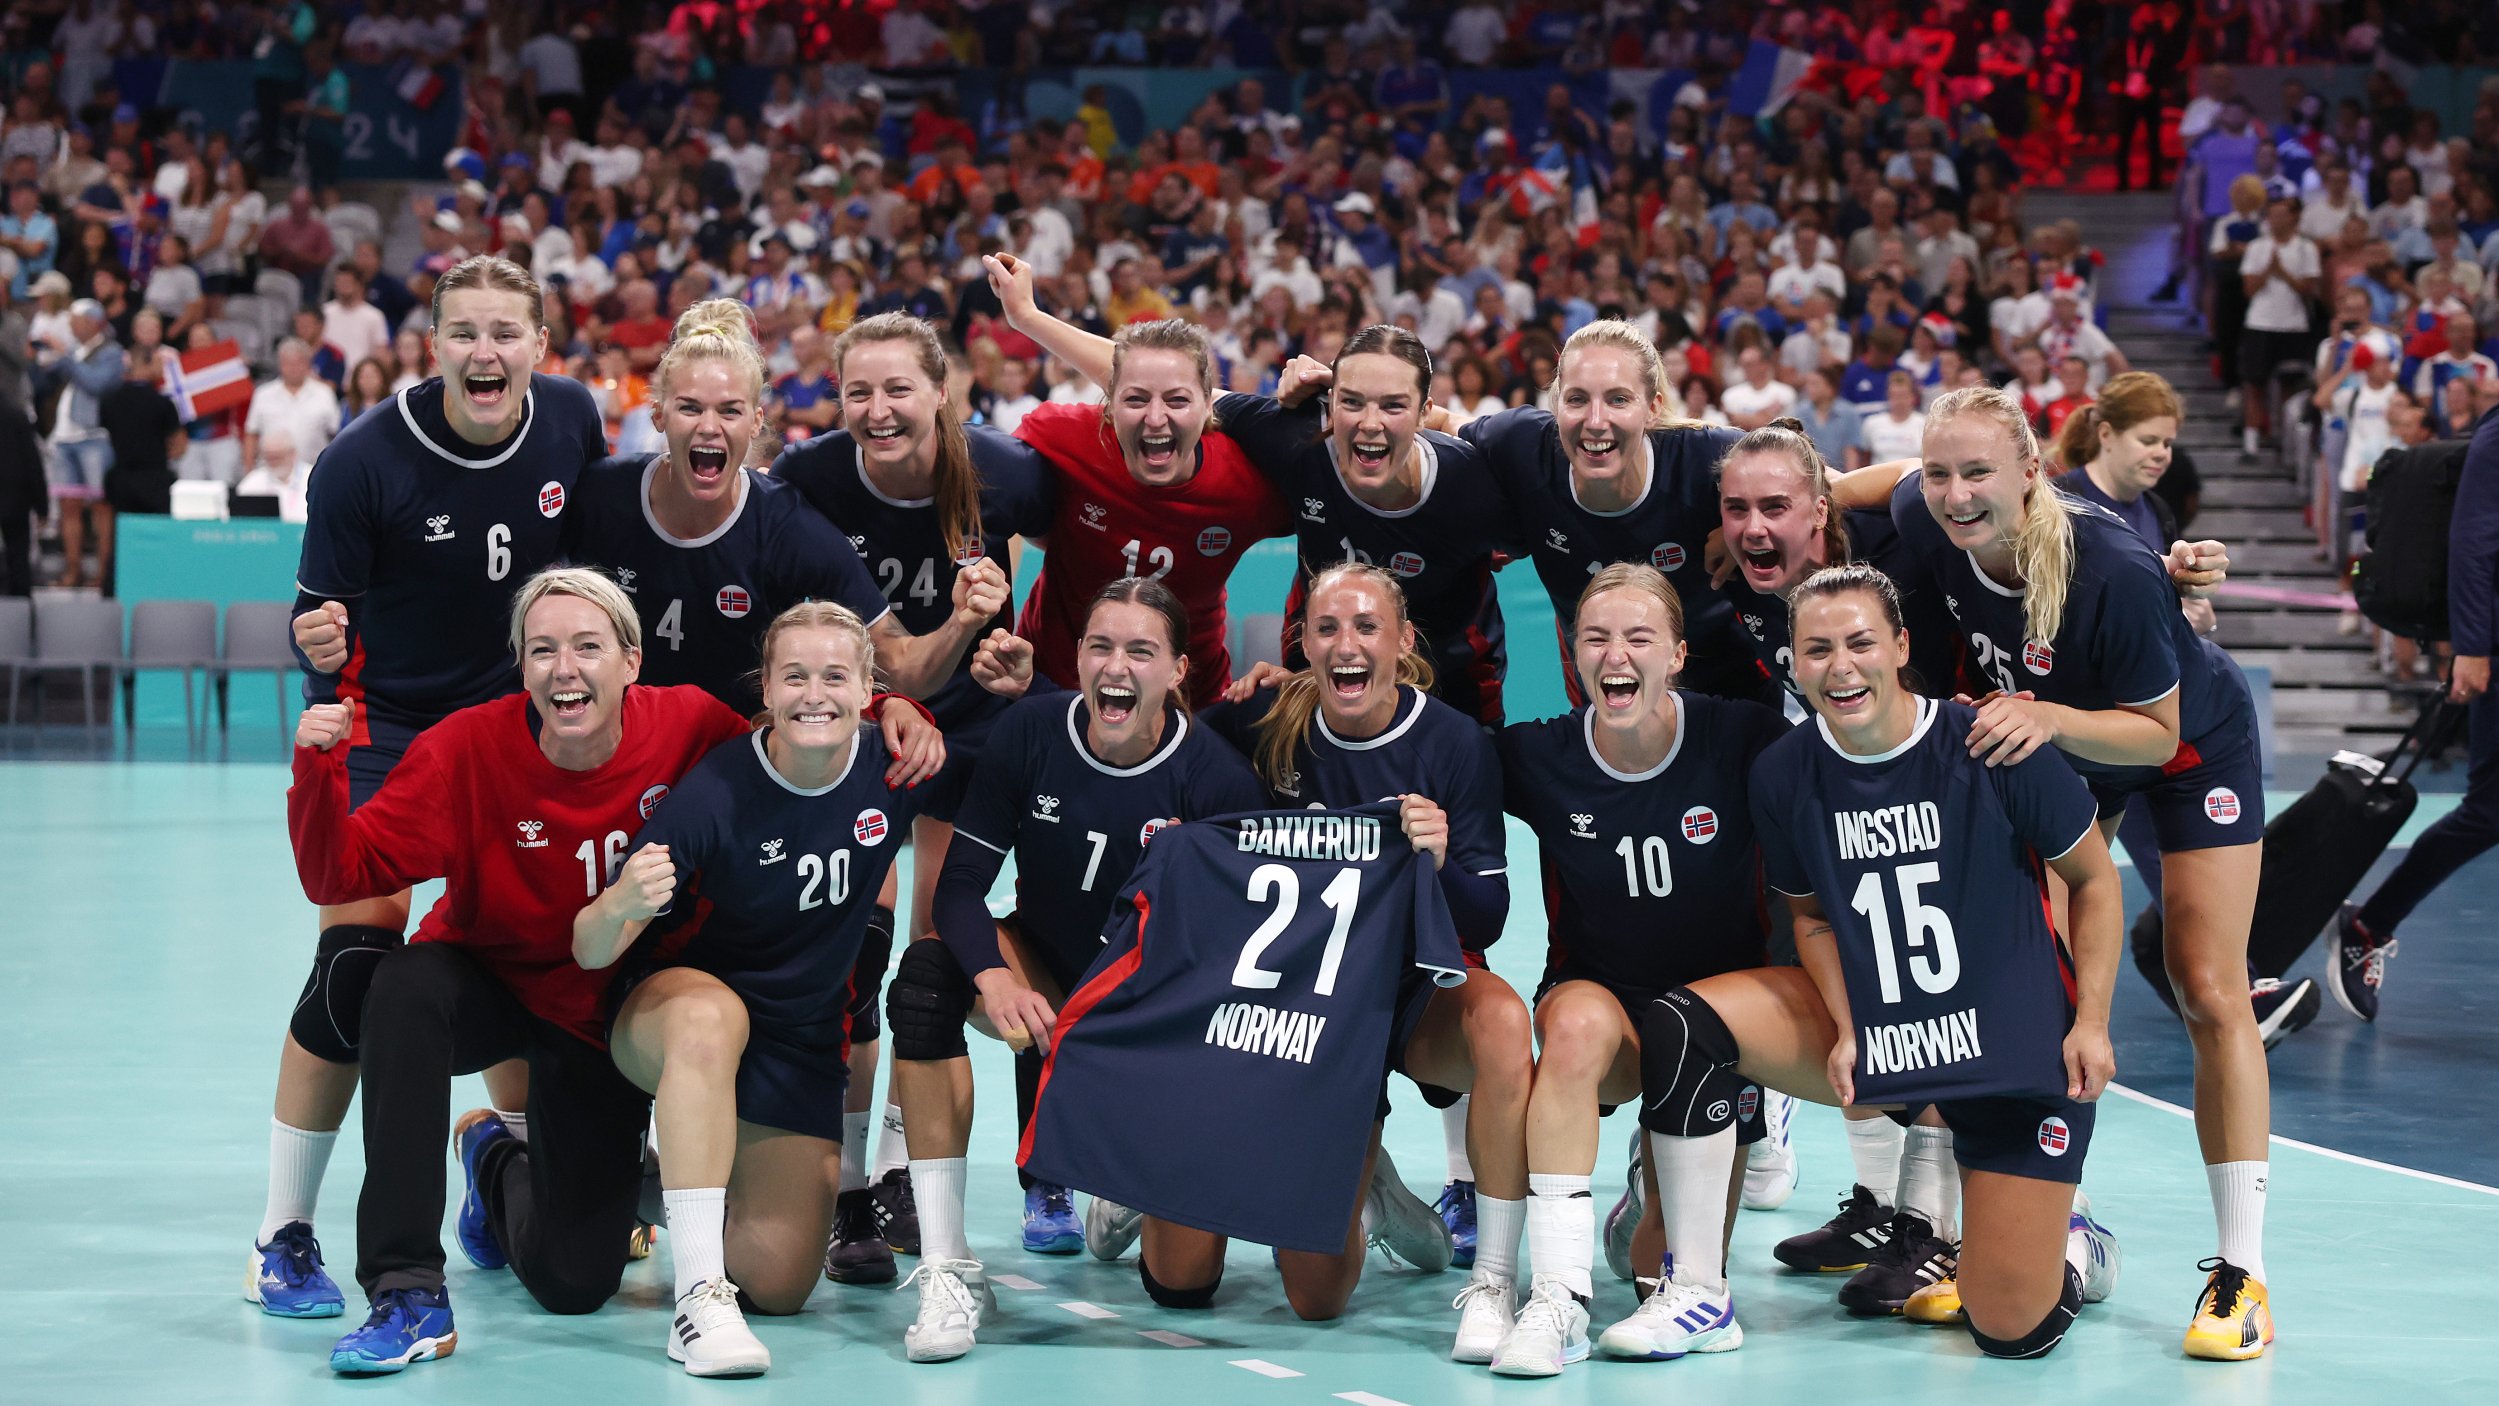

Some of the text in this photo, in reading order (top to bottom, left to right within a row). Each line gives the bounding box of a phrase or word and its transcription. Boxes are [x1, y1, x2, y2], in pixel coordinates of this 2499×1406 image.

[425, 530, 455, 542] hummel
[1079, 514, 1107, 532] hummel
[487, 523, 512, 581] 6
[1120, 539, 1174, 582] 12
[878, 557, 937, 611] 24
[656, 598, 685, 651] 4
[517, 837, 549, 848] hummel
[1031, 809, 1060, 823] hummel
[1238, 816, 1381, 862] BAKKERUD
[1569, 828, 1597, 840] hummel
[1834, 800, 1941, 860] INGSTAD
[575, 829, 631, 897] 16
[759, 851, 787, 867] hummel
[797, 848, 851, 911] 20
[1080, 829, 1108, 892] 7
[1615, 835, 1674, 898] 10
[1231, 863, 1362, 997] 21
[1851, 861, 1961, 1004] 15
[1205, 1002, 1327, 1065] NORWAY
[1864, 1008, 1983, 1075] NORWAY
